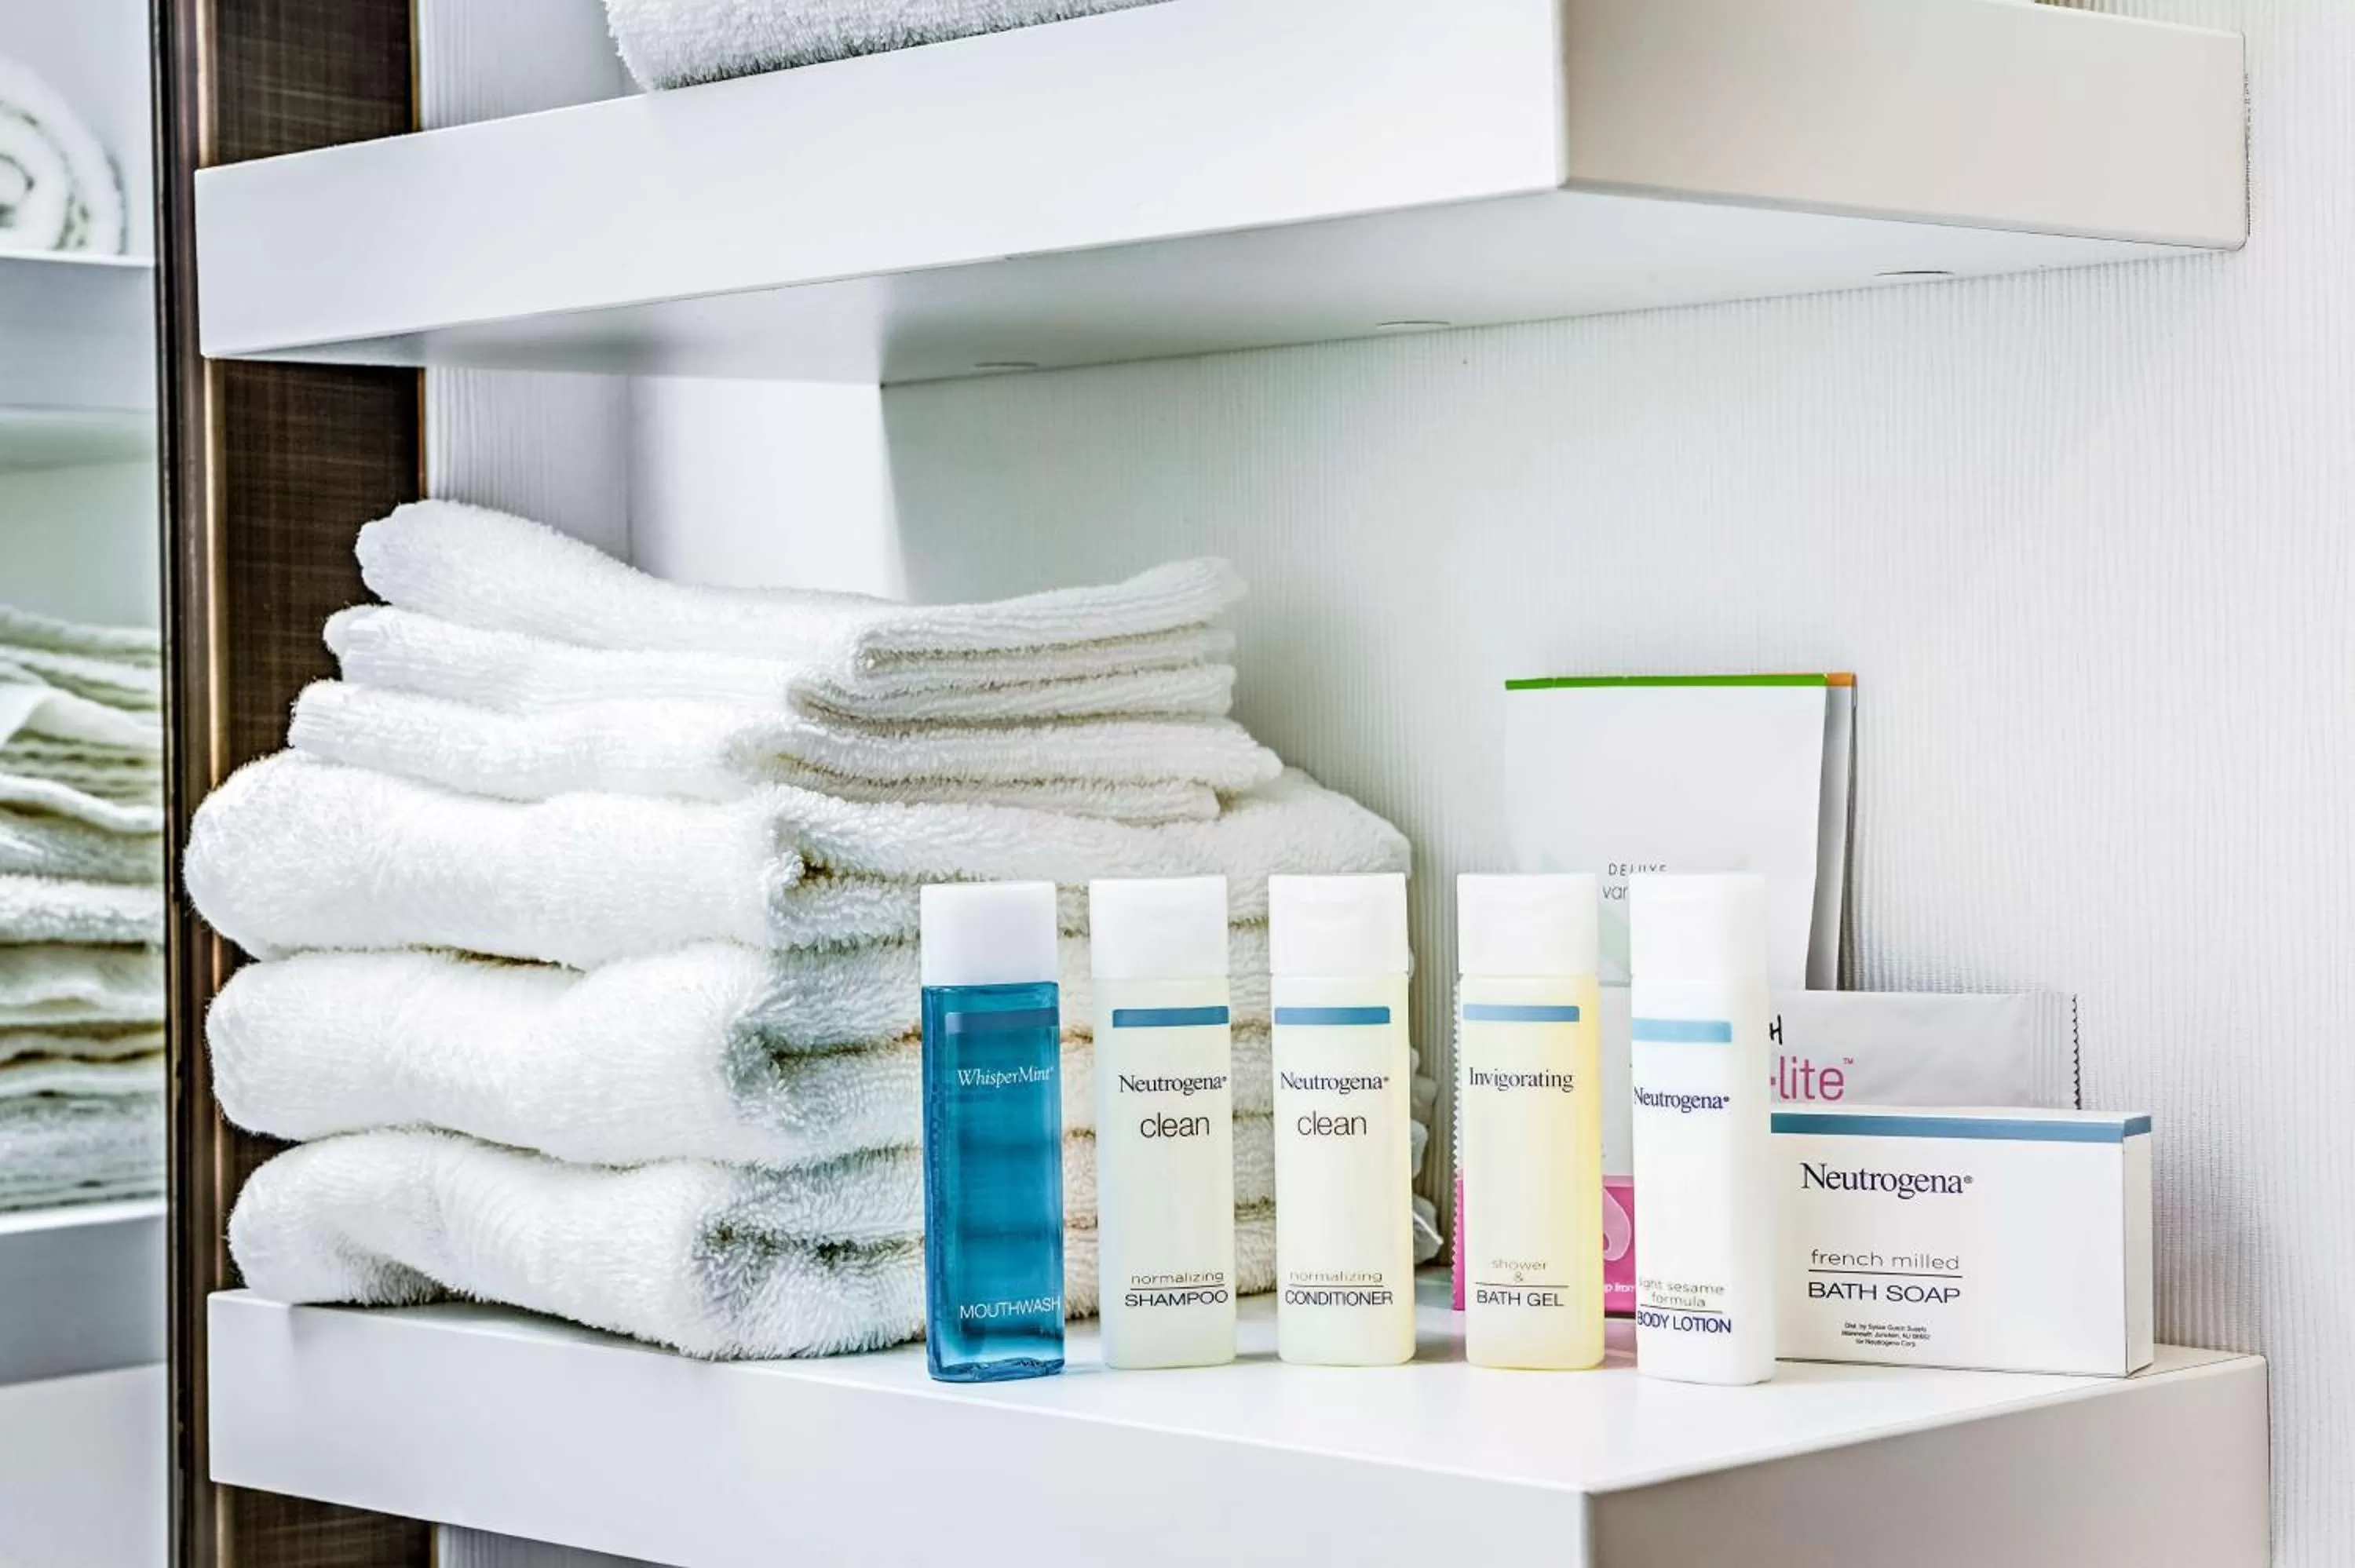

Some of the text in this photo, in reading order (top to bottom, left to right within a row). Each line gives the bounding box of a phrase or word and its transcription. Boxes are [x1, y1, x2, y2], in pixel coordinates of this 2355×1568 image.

[1470, 1067, 1575, 1093] Invigorating
[1140, 1111, 1210, 1138] clean
[1297, 1110, 1367, 1136] clean
[1492, 1258, 1546, 1271] shower
[1811, 1249, 1959, 1271] french milled
[1131, 1271, 1225, 1285] normalizing
[1290, 1270, 1383, 1284] normalizing
[1513, 1271, 1523, 1282] &
[1667, 1282, 1725, 1295] sesame
[1809, 1281, 1961, 1304] BATH SOAP
[1124, 1289, 1229, 1307] SHAMPOO
[1285, 1289, 1393, 1307] CONDITIONER
[1477, 1289, 1565, 1307] BATH GEL
[1652, 1292, 1707, 1307] formula
[959, 1296, 1061, 1319] MOUTHWASH
[1638, 1311, 1732, 1333] BODY LOTION
